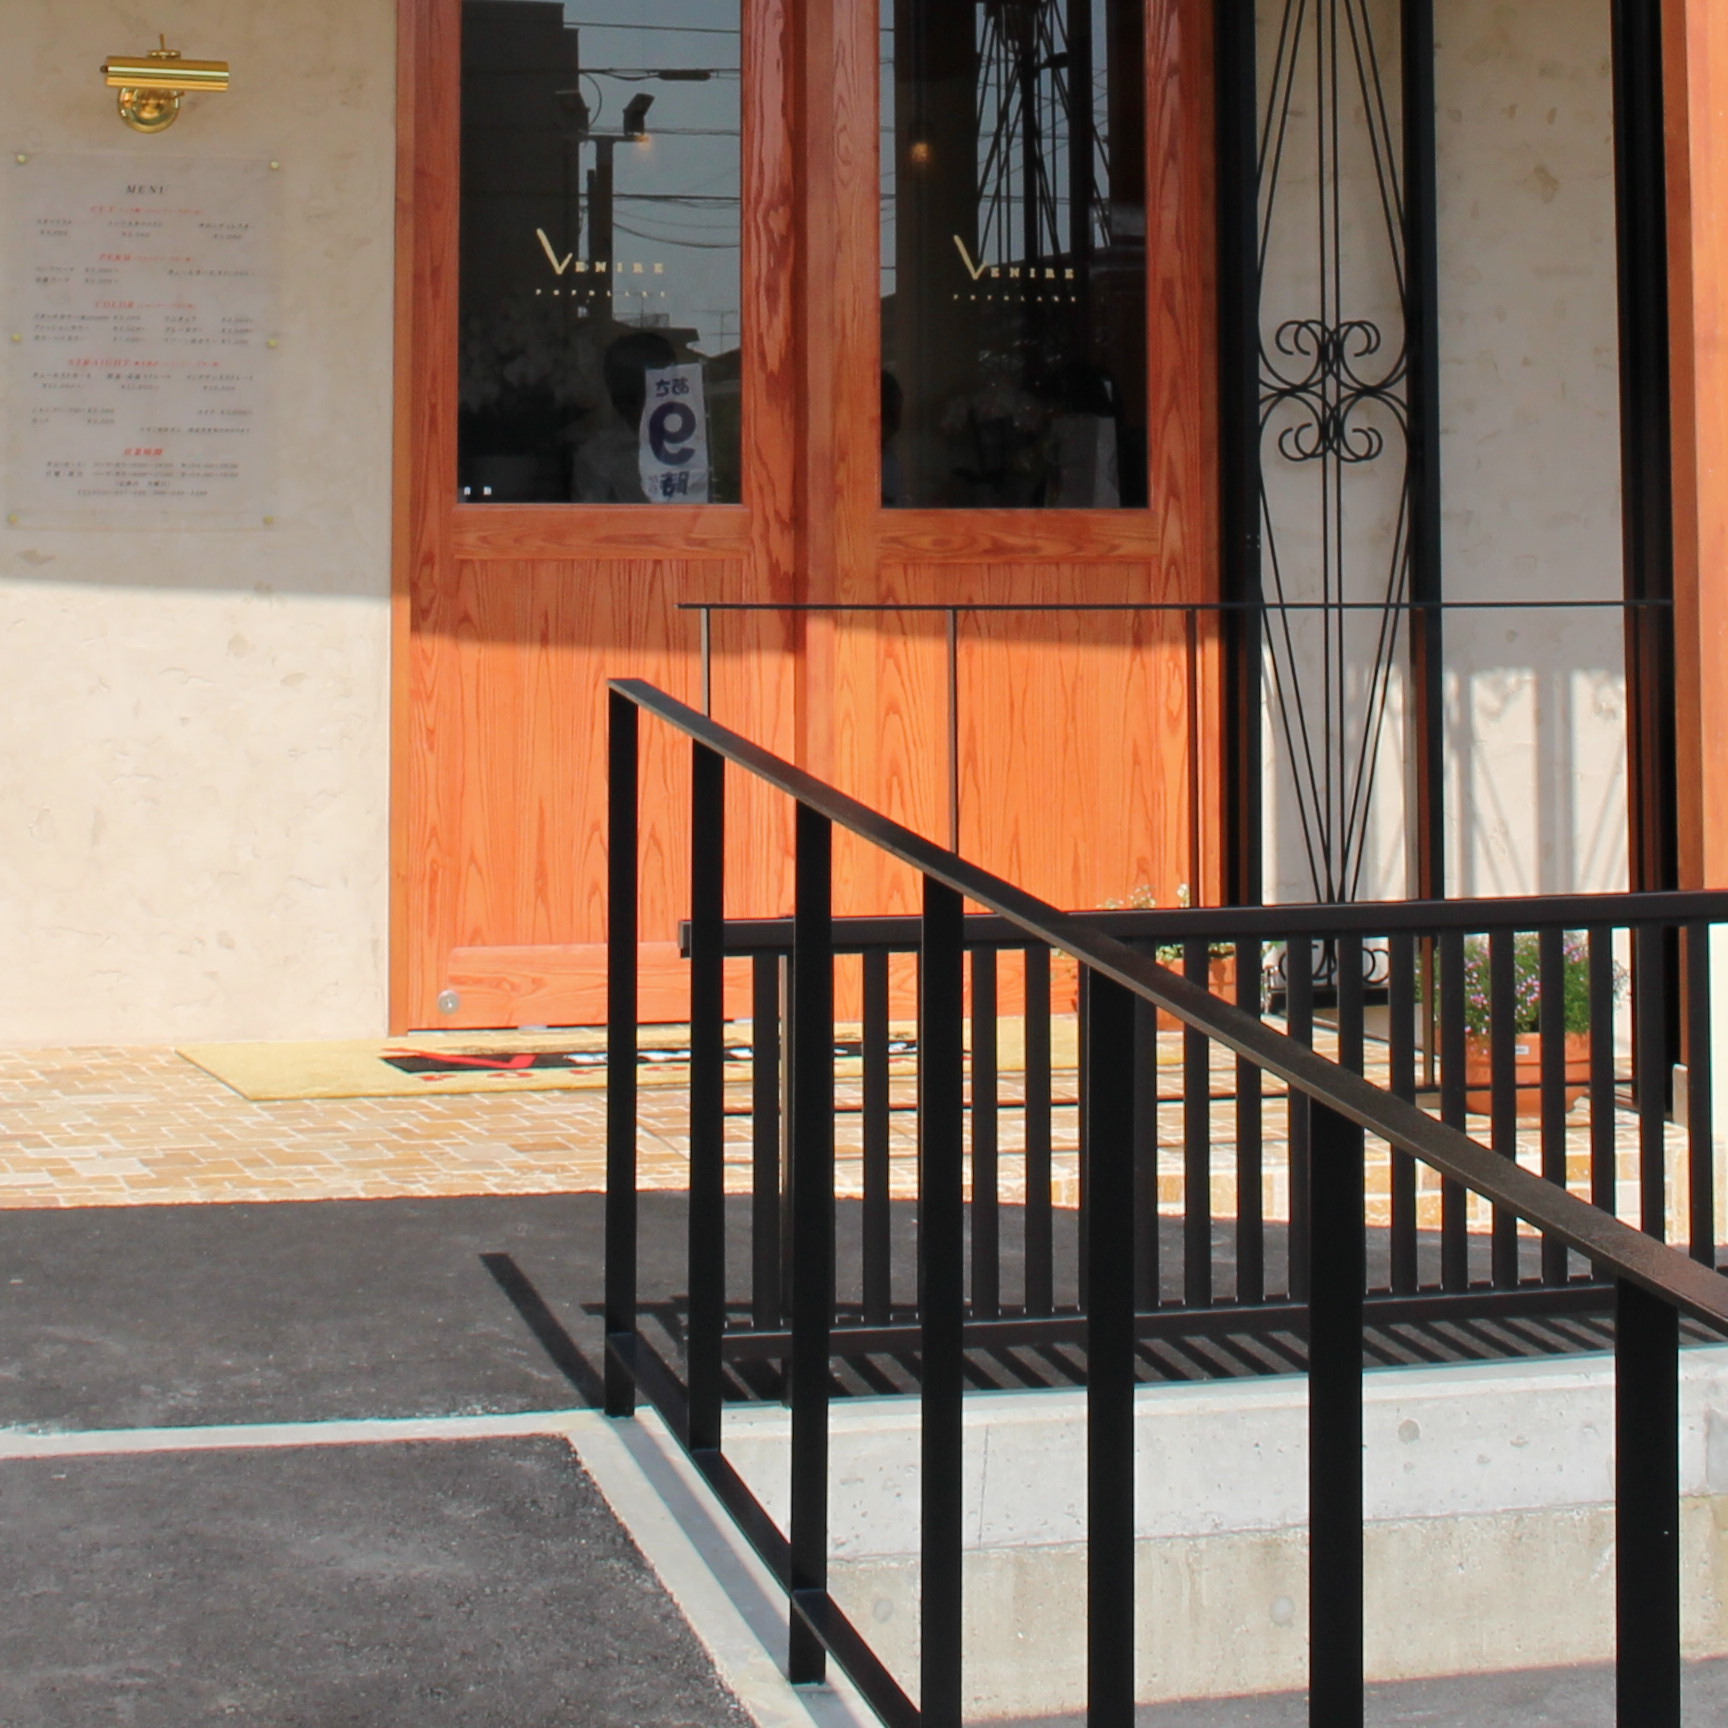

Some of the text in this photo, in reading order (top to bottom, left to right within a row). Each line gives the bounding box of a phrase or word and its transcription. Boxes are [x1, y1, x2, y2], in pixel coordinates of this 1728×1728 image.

[125, 184, 170, 194] MENU
[536, 227, 665, 275] VENIRE
[953, 234, 1075, 281] VENIRE
[95, 300, 135, 309] COLOR
[68, 358, 130, 367] STRAIGHT
